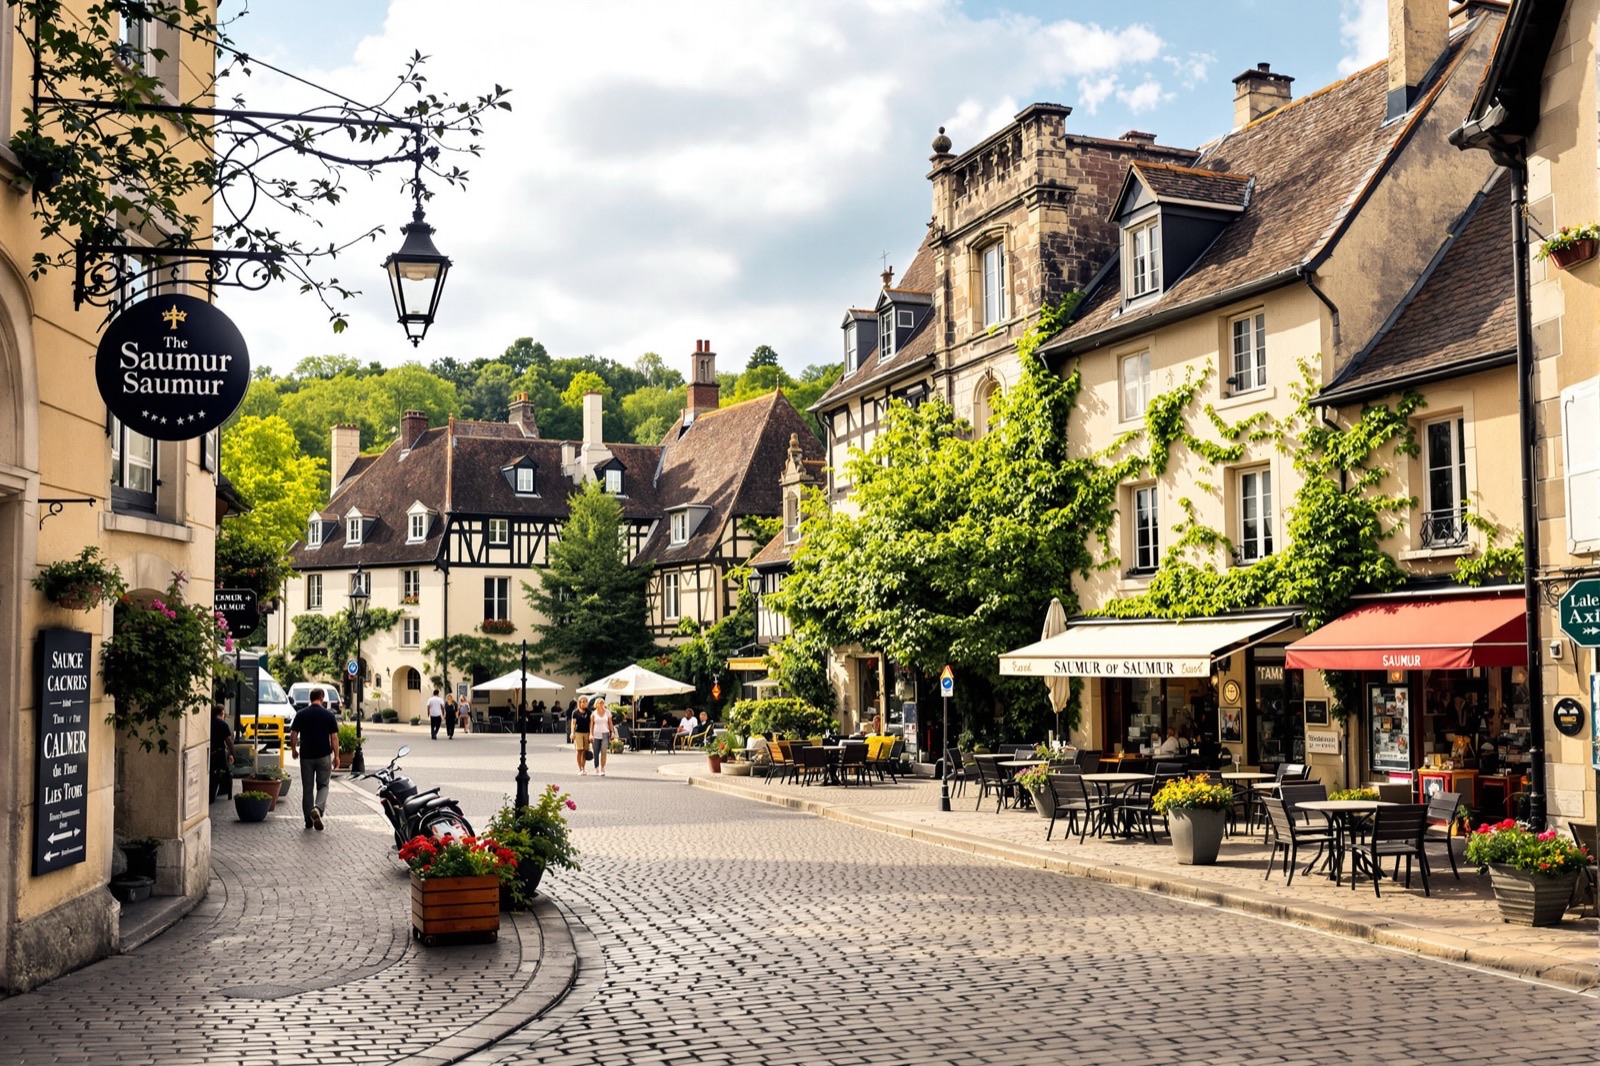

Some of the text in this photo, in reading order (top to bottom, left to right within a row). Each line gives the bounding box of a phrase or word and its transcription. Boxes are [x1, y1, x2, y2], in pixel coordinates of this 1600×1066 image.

[163, 336, 189, 349] The
[119, 341, 233, 373] Saumur
[122, 371, 224, 396] Saumur
[1570, 594, 1600, 607] Lale
[1054, 660, 1101, 674] SAUMUR
